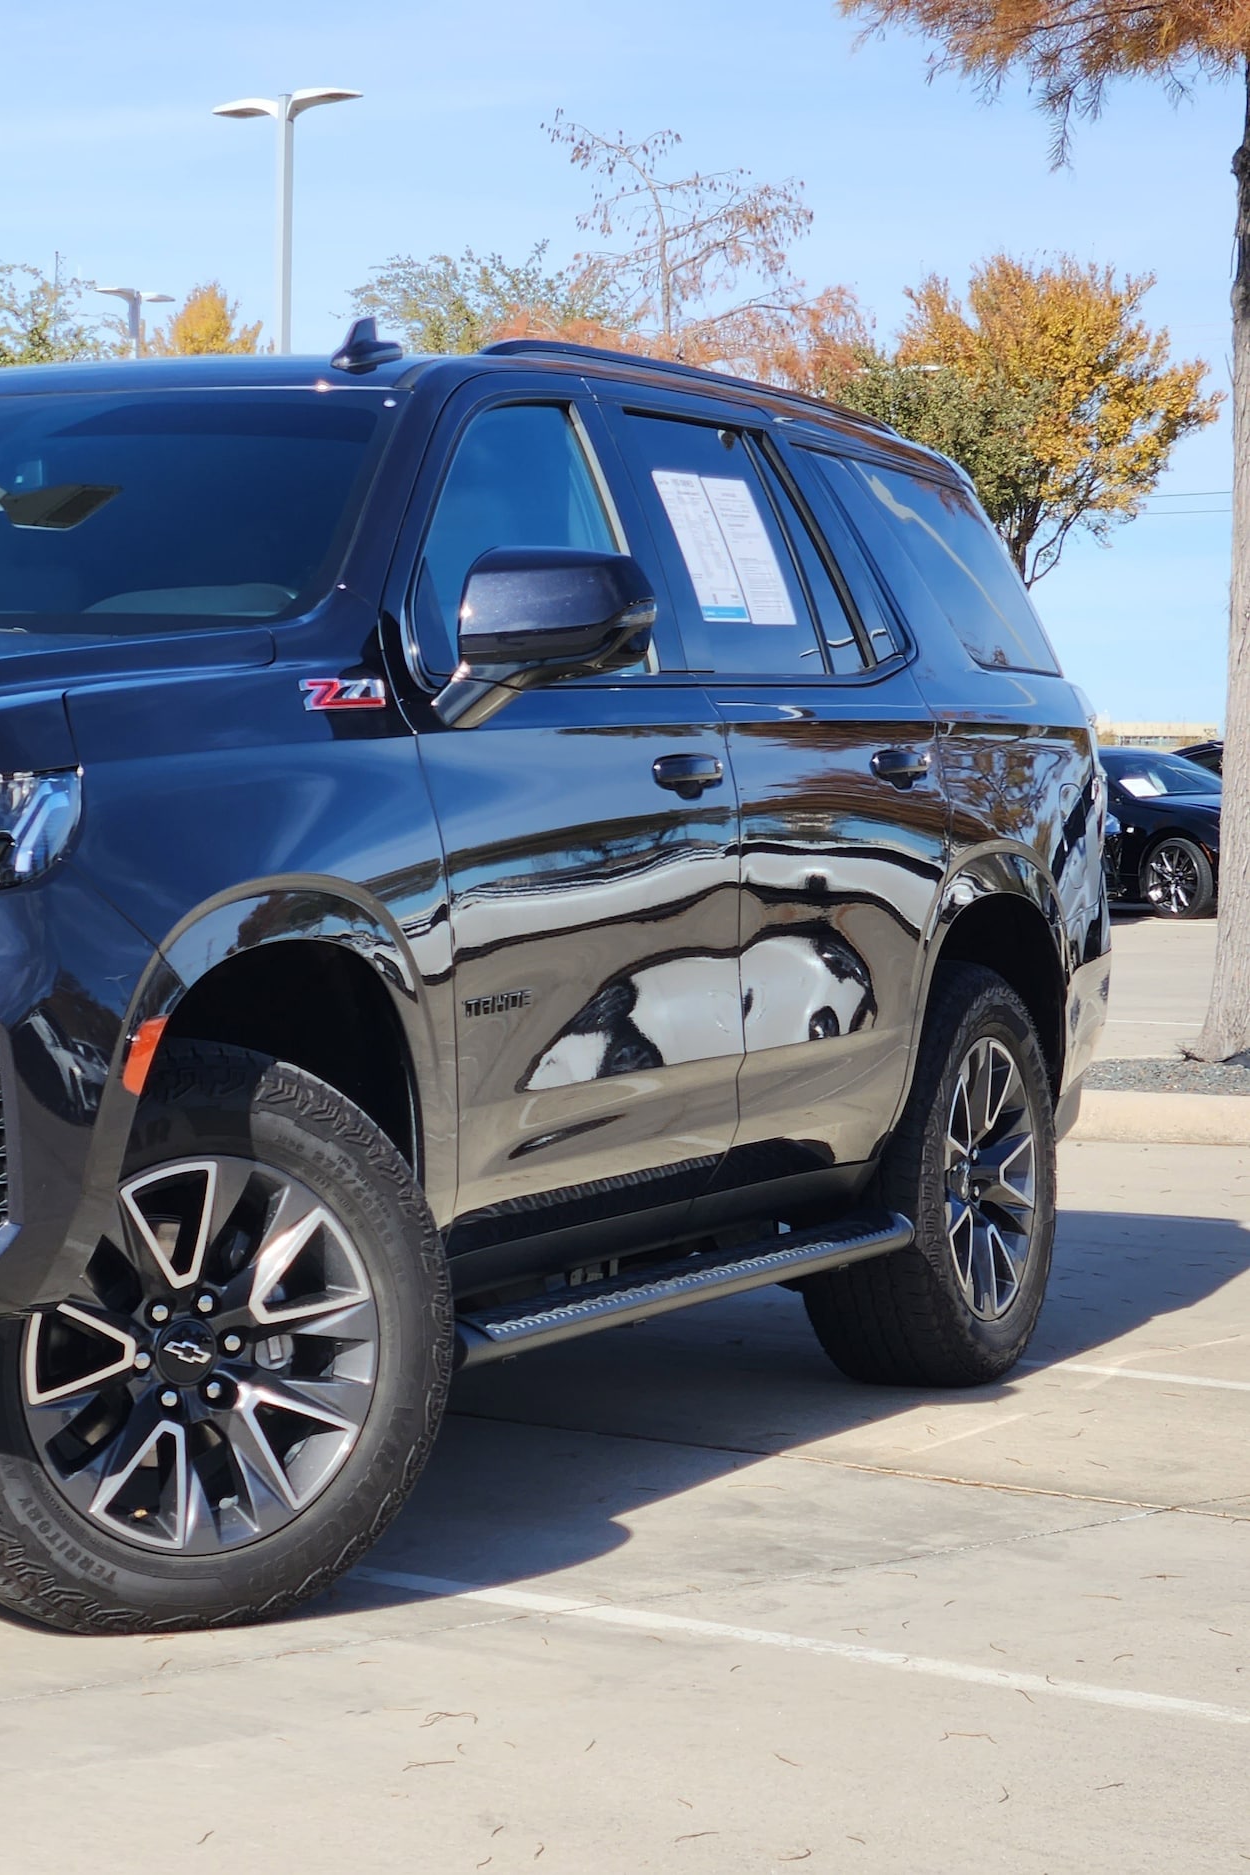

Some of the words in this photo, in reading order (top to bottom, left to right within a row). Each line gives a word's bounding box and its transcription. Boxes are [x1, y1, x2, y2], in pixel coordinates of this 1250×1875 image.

[299, 678, 386, 711] Z71
[463, 989, 533, 1017] TAHOE
[17, 1496, 117, 1585] TERRITORY
